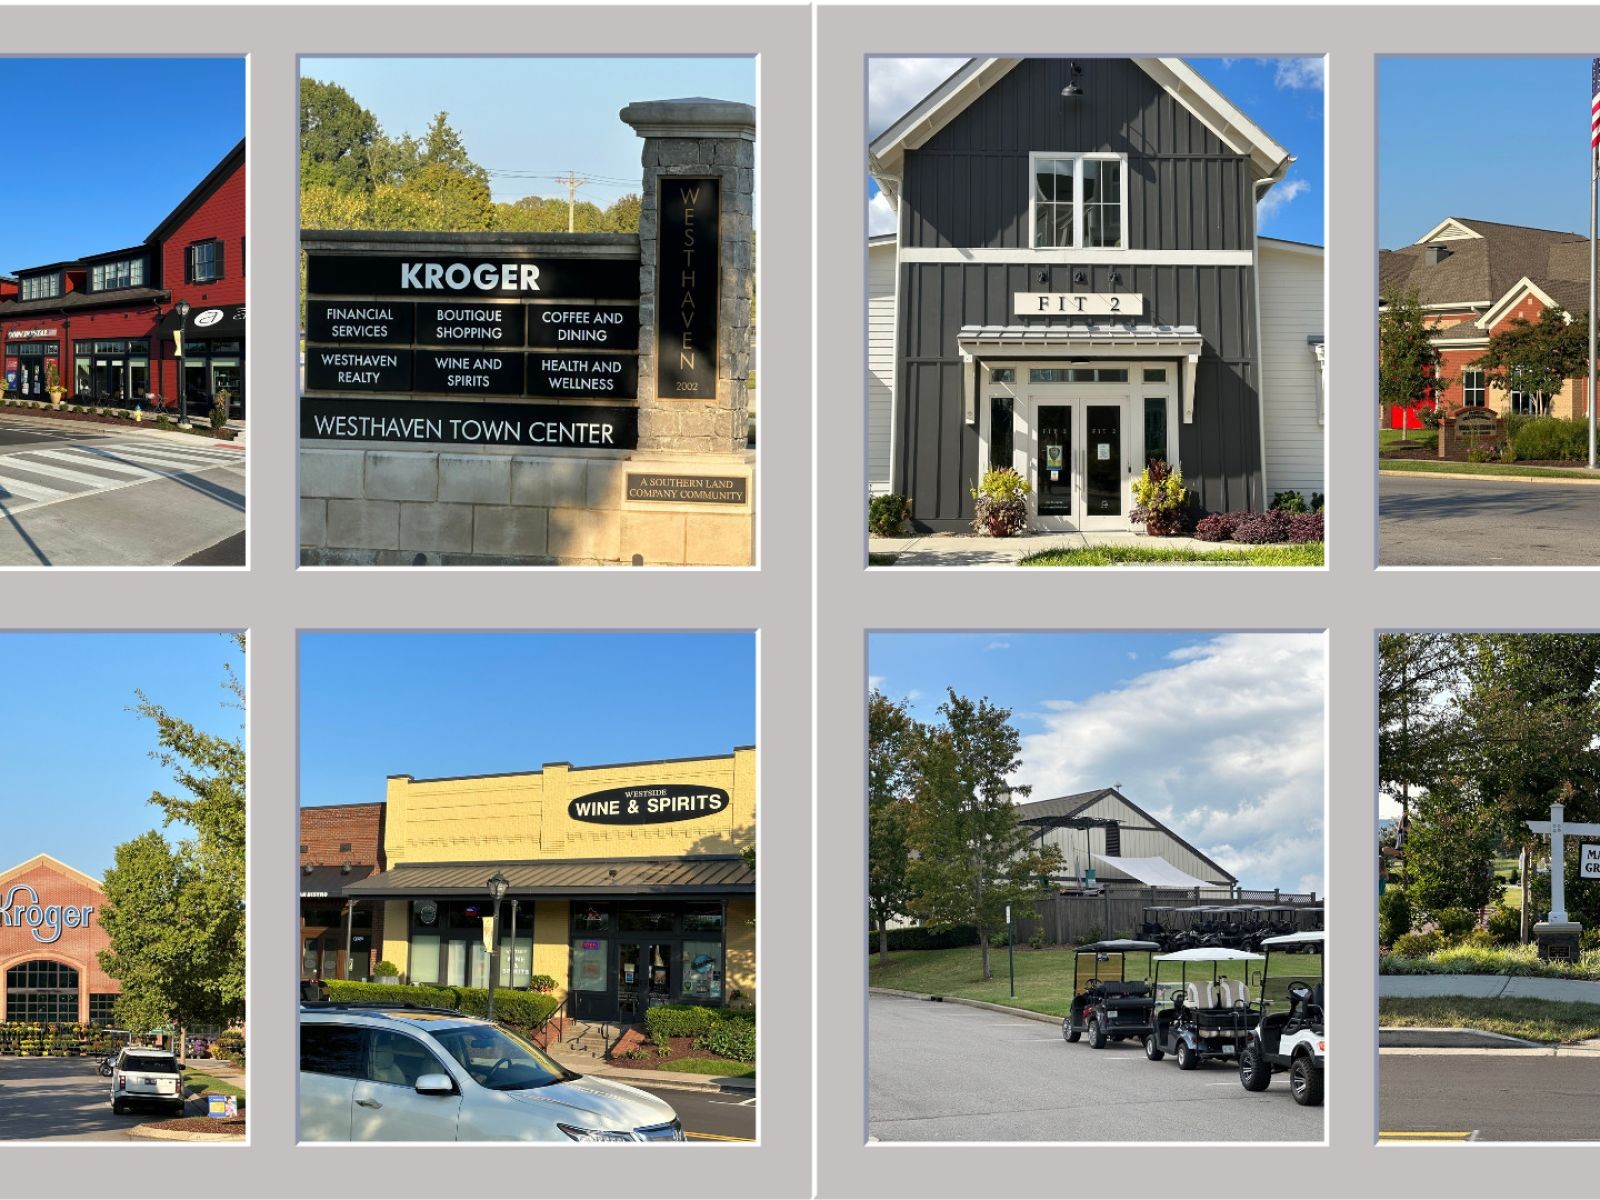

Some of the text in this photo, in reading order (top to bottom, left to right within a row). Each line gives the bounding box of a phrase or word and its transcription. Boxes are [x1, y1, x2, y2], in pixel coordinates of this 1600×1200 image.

[401, 263, 541, 291] KROGER
[680, 187, 700, 371] WESTHAVEN
[1038, 296, 1120, 312] FIT 2
[327, 308, 394, 320] FINANCIAL
[437, 309, 502, 322] BOUTIQUE
[541, 311, 624, 324] COFFEE AND
[331, 325, 388, 337] SERVICES
[436, 326, 502, 339] SHOPPING
[558, 329, 608, 342] DINING
[321, 354, 397, 367] WESTHAVEN
[435, 357, 502, 370] WINE AND
[541, 359, 622, 373] HEALTH AND
[338, 371, 380, 384] REALTY
[447, 375, 490, 387] SPIRITS
[548, 377, 614, 391] WELLNESS
[676, 381, 698, 391] 2002
[313, 415, 614, 445] WESTHAVEN TOWN CENTER
[640, 478, 734, 489] A SOUTHERN LAND
[629, 488, 743, 500] COMPANY COMMUNITY
[625, 789, 667, 798] WESTSIDE
[575, 794, 722, 816] WINE & SPIRITS
[0, 884, 94, 943] Kroger
